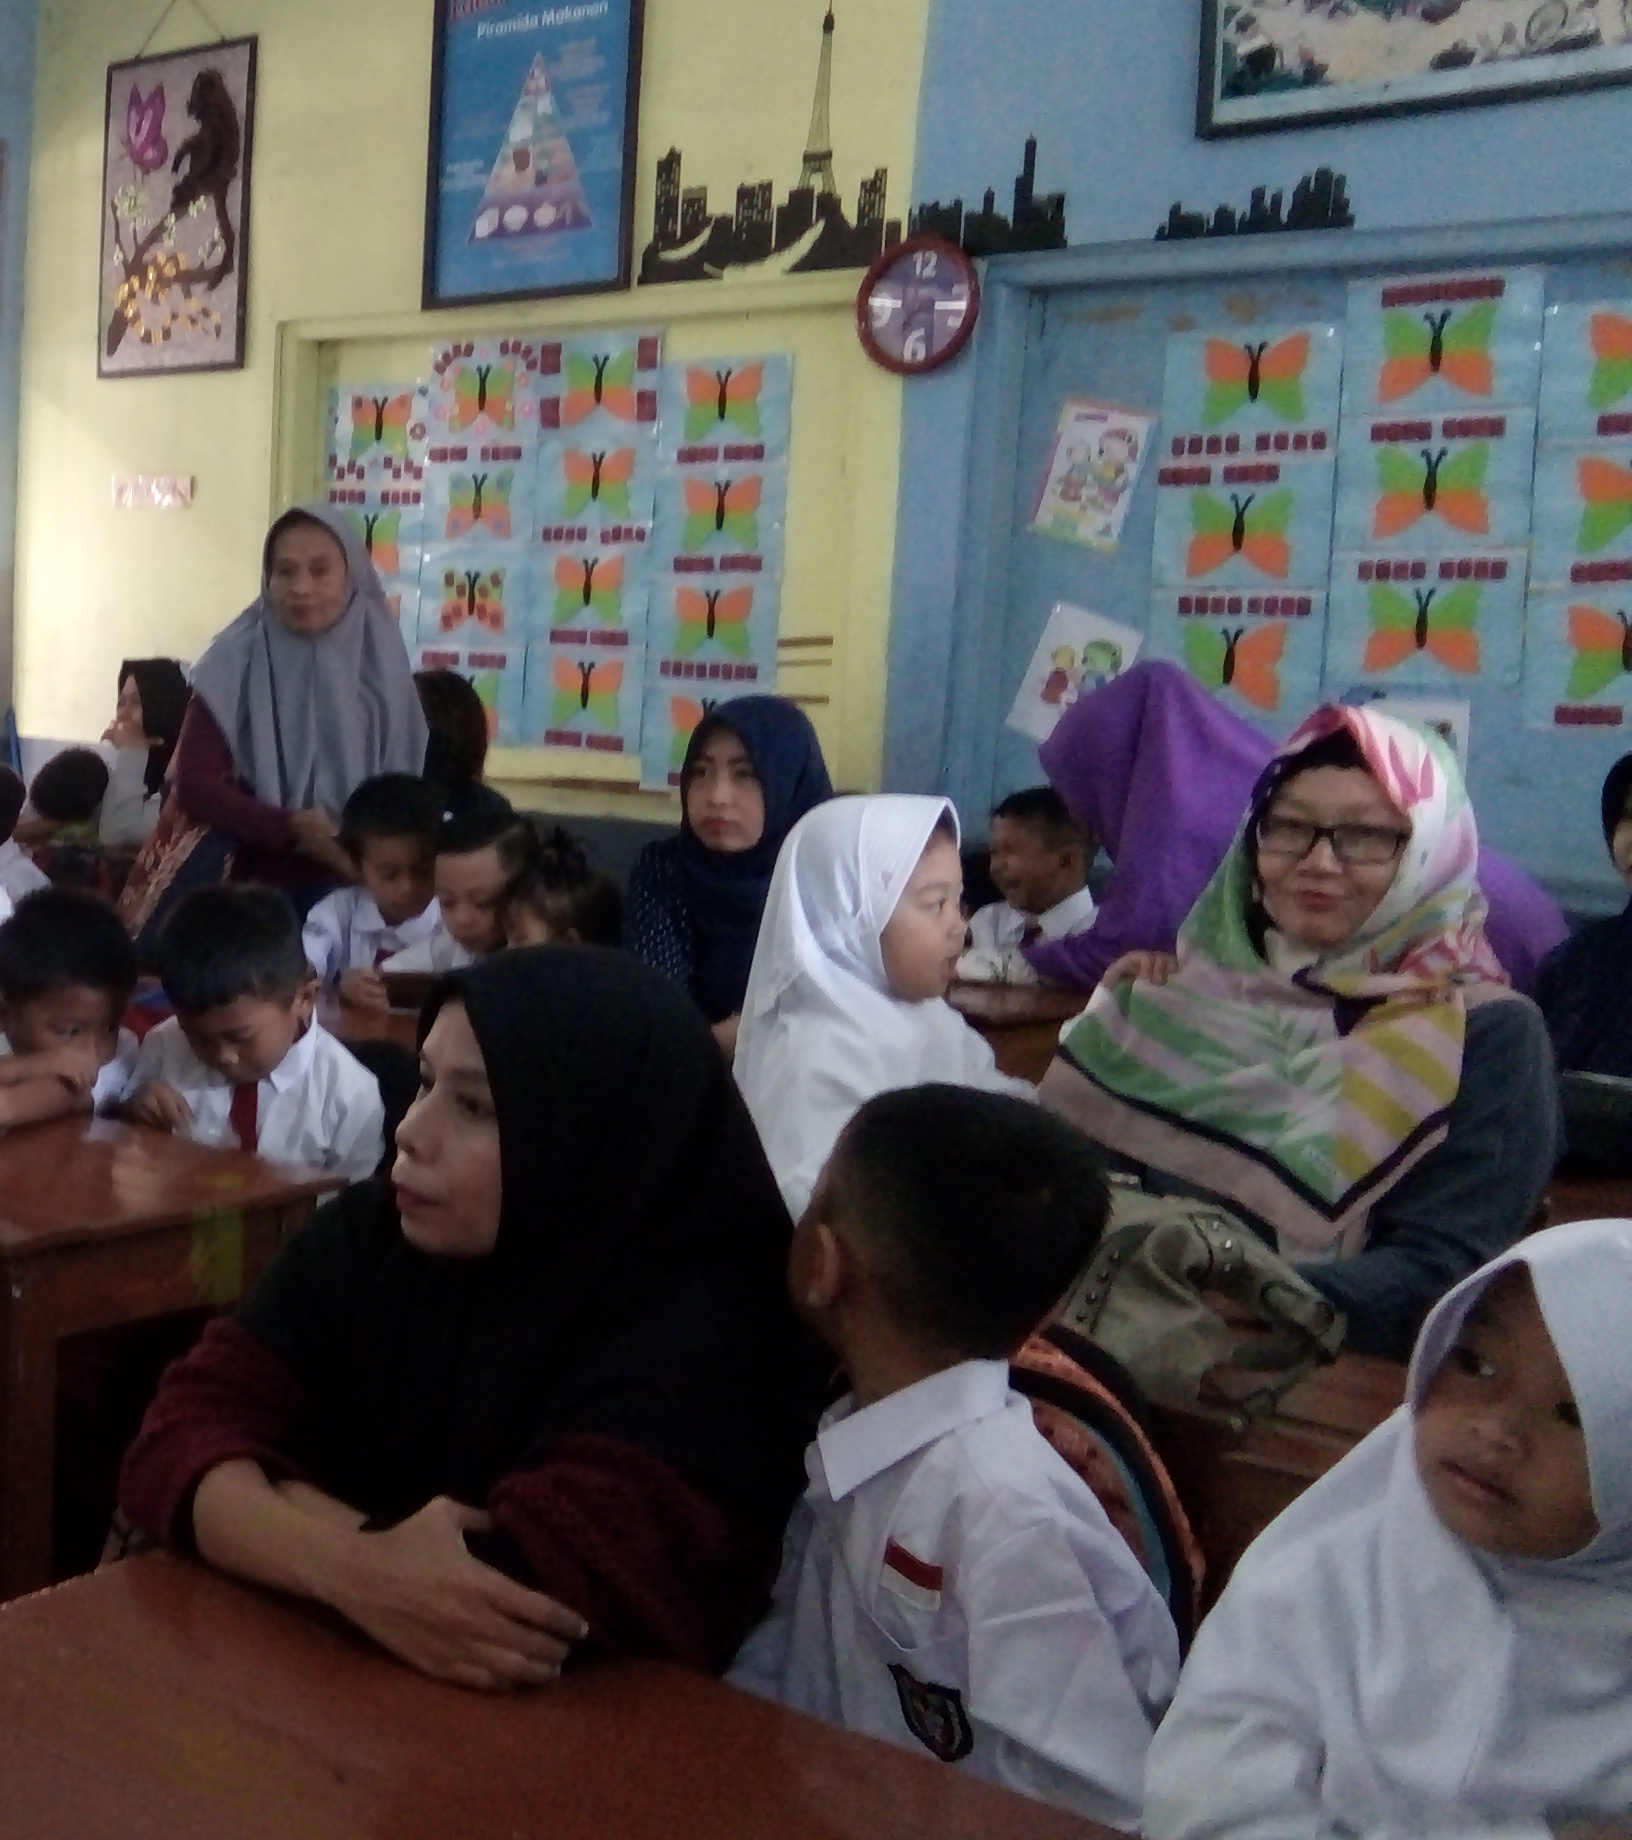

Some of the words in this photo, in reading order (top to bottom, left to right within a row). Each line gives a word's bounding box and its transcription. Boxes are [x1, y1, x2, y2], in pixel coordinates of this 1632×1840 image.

[477, 12, 538, 38] Piramida
[541, 1, 609, 26] Makanan
[912, 250, 937, 278] 12
[903, 327, 926, 363] 6
